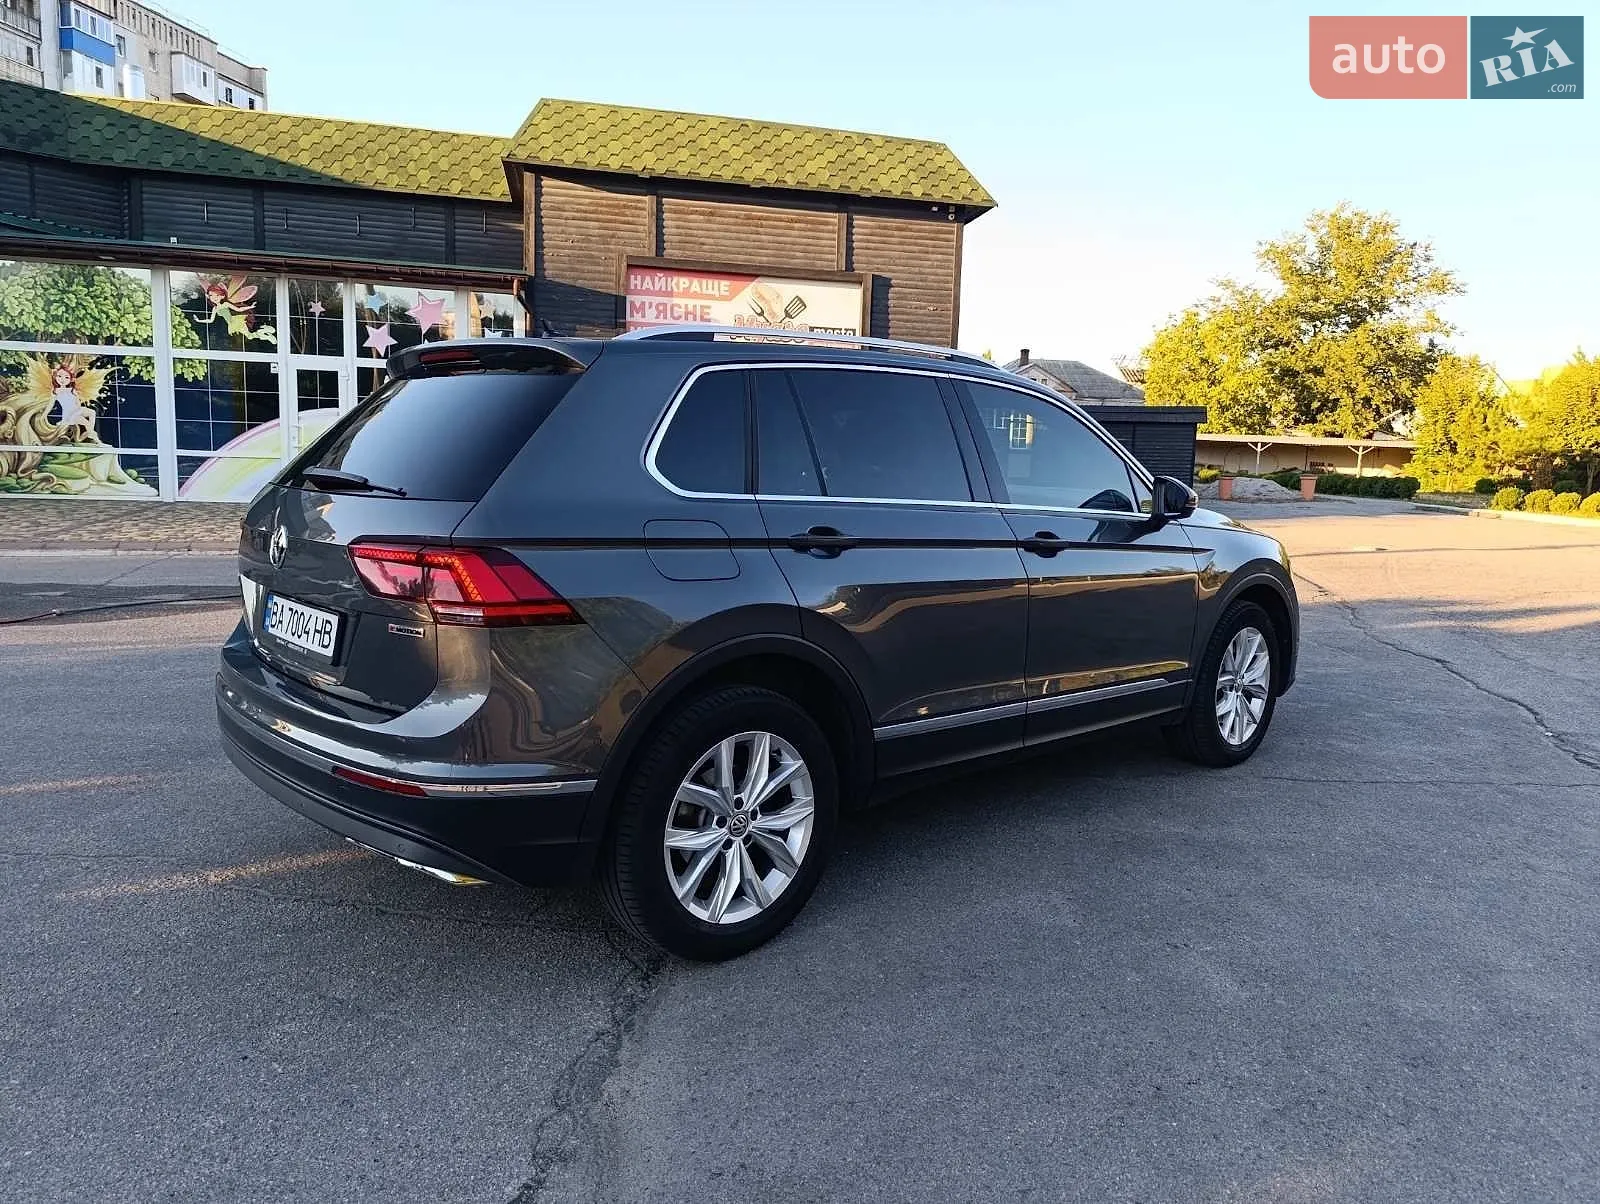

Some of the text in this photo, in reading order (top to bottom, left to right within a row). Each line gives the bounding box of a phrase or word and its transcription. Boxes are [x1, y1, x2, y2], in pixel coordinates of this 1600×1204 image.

[629, 273, 731, 297] НАЙКРАЩЕ
[629, 300, 713, 322] М'ЯСНЕ
[270, 602, 285, 633] BA
[285, 607, 313, 644] 7004
[312, 615, 334, 650] HB
